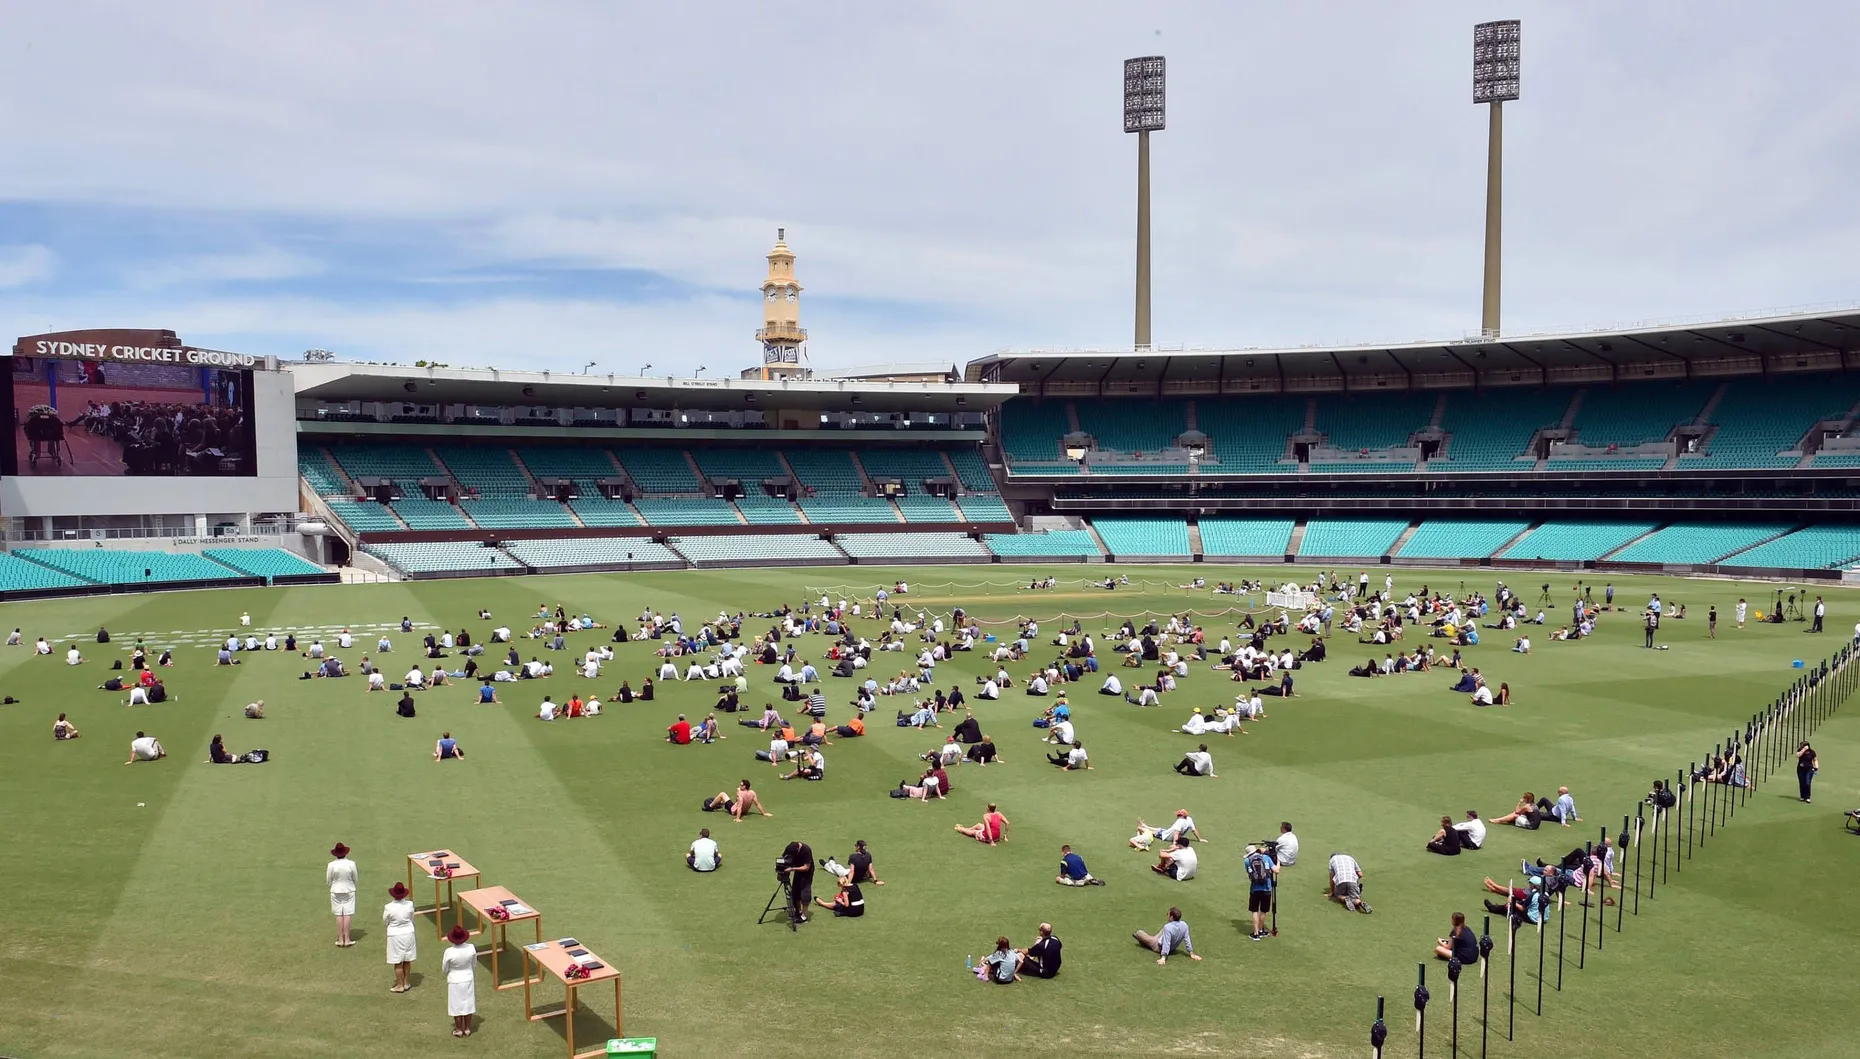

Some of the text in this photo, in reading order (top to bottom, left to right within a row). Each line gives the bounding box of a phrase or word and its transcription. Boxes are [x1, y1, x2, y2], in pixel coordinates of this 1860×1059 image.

[36, 340, 255, 367] SYDNEY CRICKET GROUND
